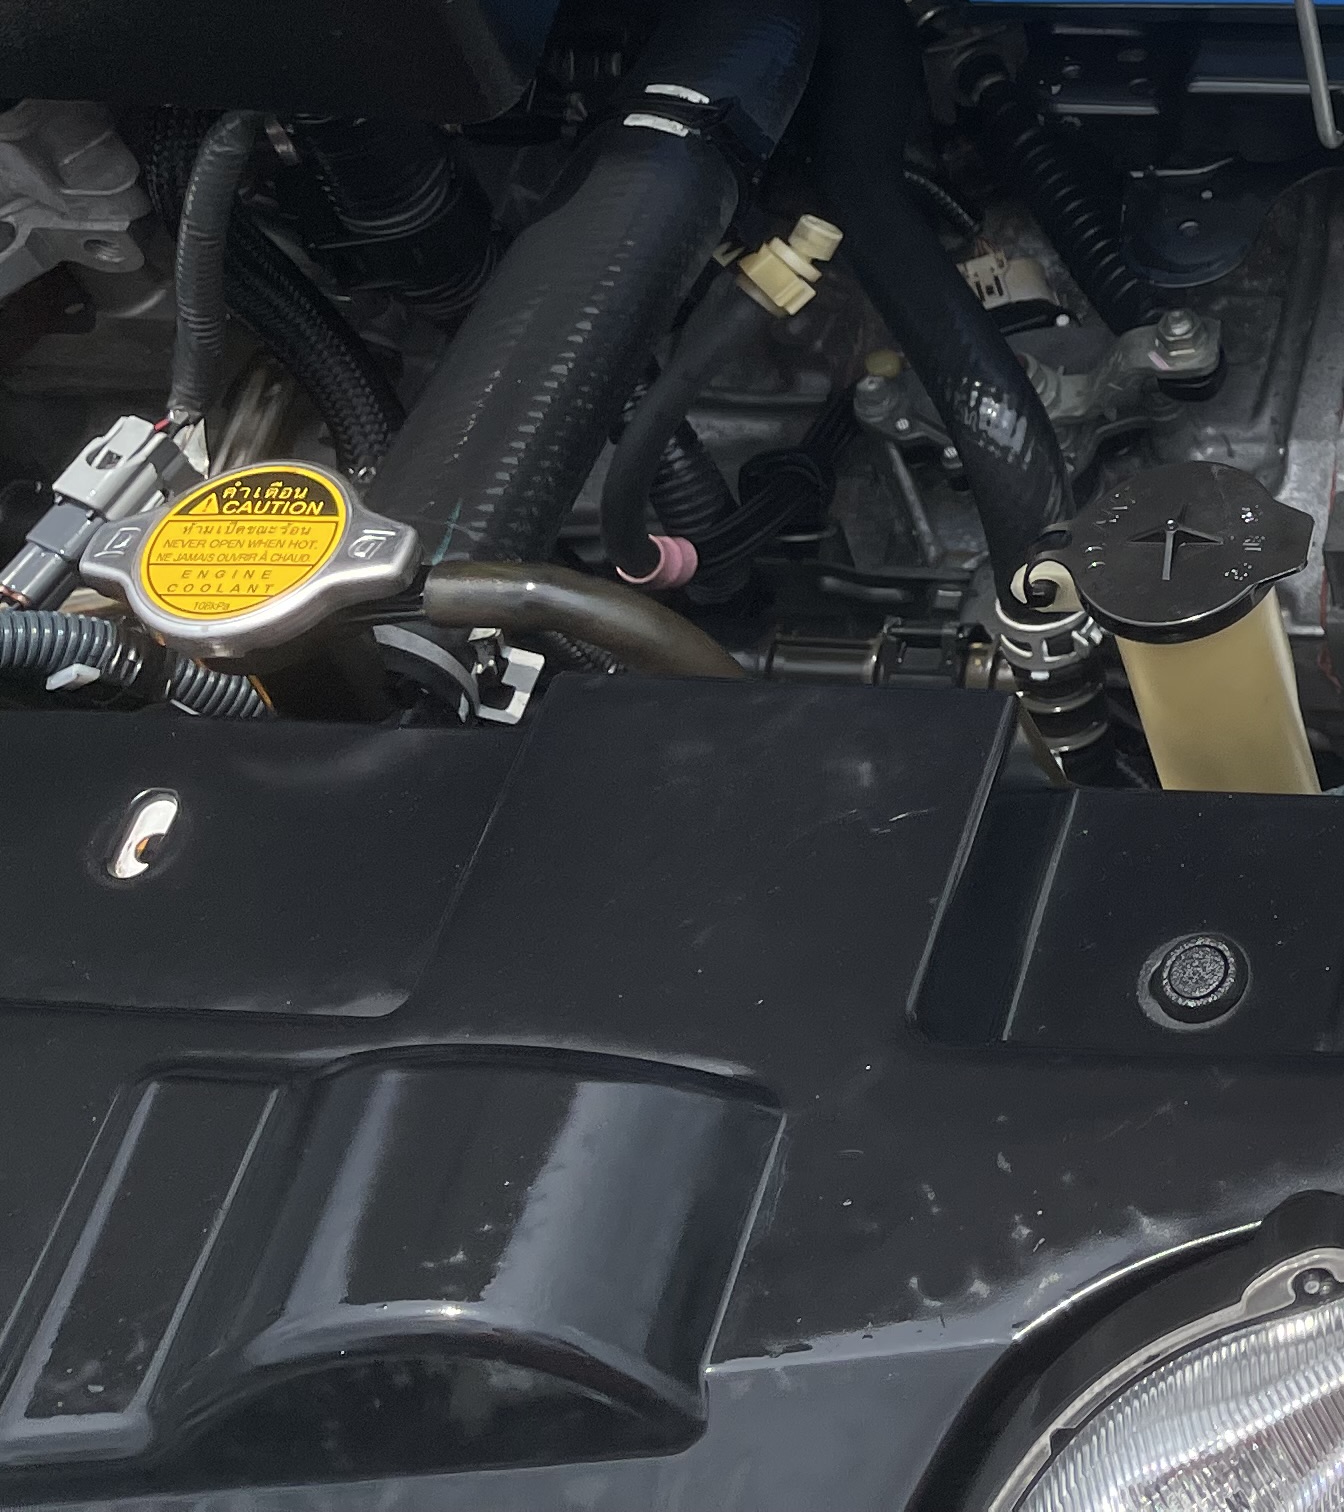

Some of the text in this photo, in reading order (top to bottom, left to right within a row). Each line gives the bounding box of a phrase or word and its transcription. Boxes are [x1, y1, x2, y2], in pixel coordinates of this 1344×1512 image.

[222, 481, 308, 500] คำเตือน
[222, 500, 324, 516] CAUTION
[163, 538, 318, 550] NEVER OPEN WHEN HOT.
[156, 551, 172, 562] NE
[173, 552, 215, 563] JAMAIS
[216, 552, 257, 563] OUVRIR
[259, 548, 269, 563] À
[182, 569, 273, 580] ENGINE
[167, 583, 275, 594] COOLANT
